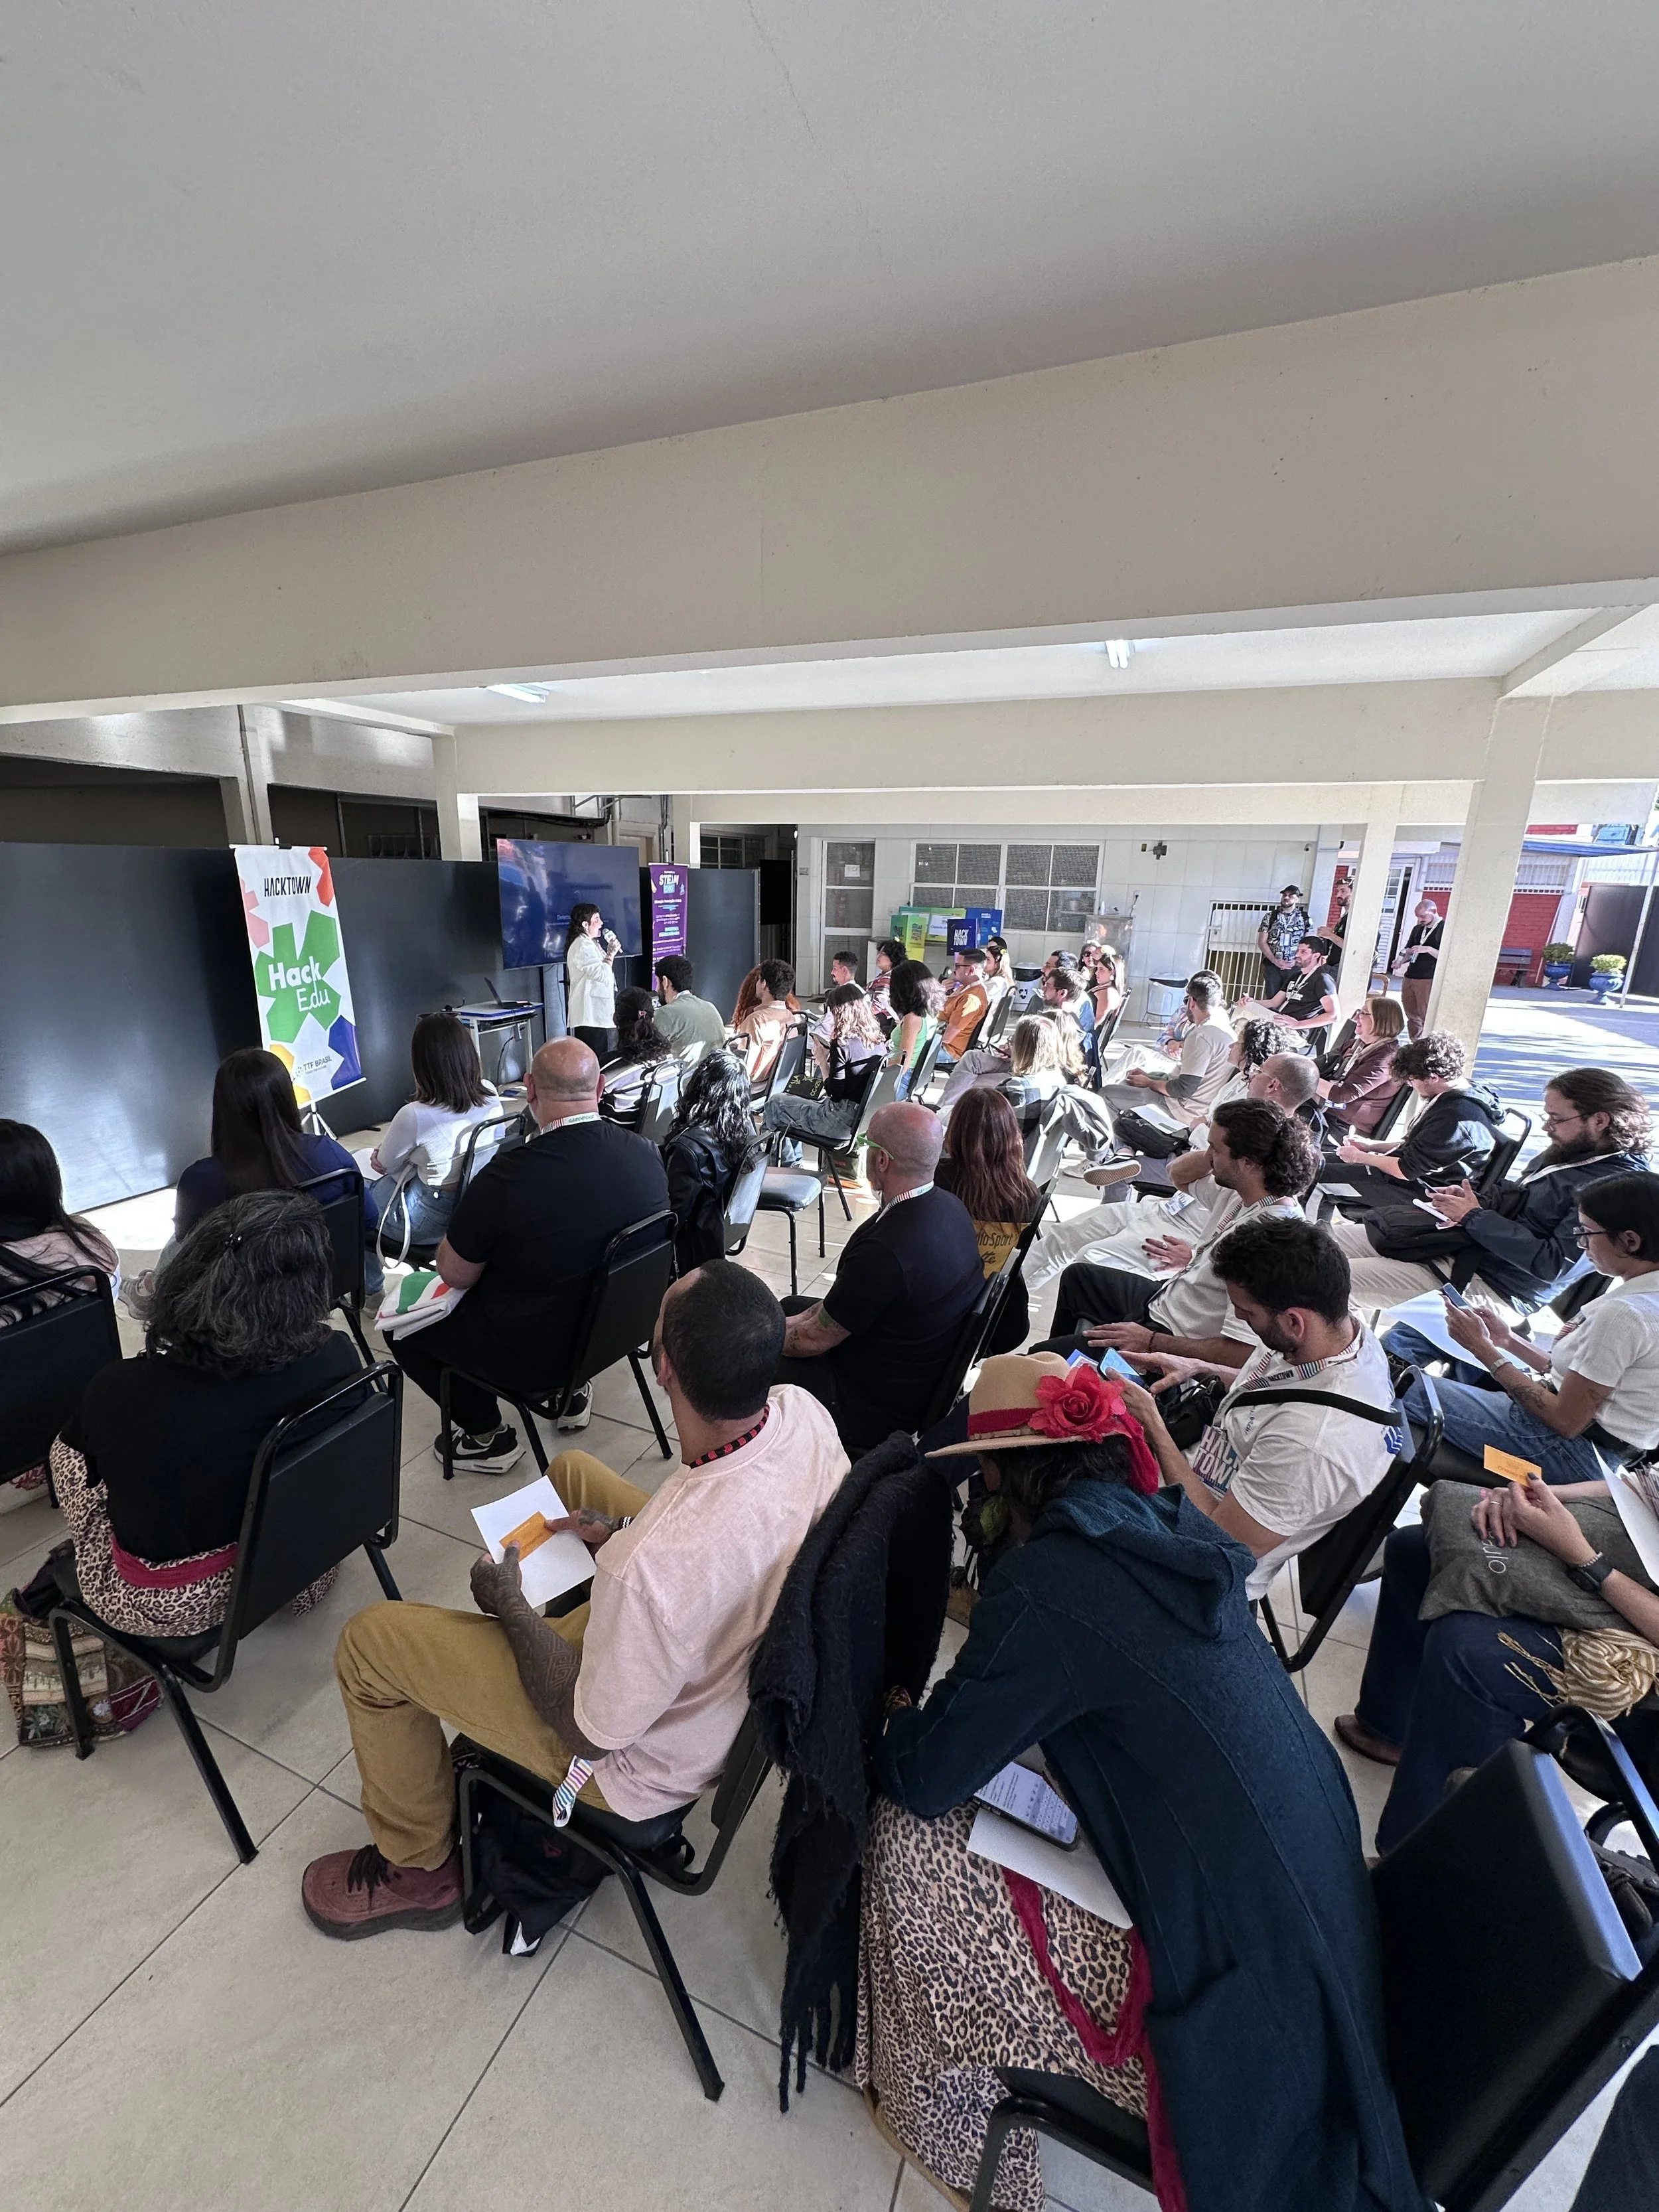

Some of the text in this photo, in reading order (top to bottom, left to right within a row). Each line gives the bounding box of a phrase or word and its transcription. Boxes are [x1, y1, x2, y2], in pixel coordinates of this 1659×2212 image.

[264, 875, 311, 897] HACKTOWN
[953, 936, 968, 946] TOWN
[954, 929, 969, 938] HACK
[268, 956, 322, 991] Hack
[296, 981, 330, 1012] Edu
[303, 1061, 314, 1070] TTF
[315, 1055, 332, 1067] BRASIL
